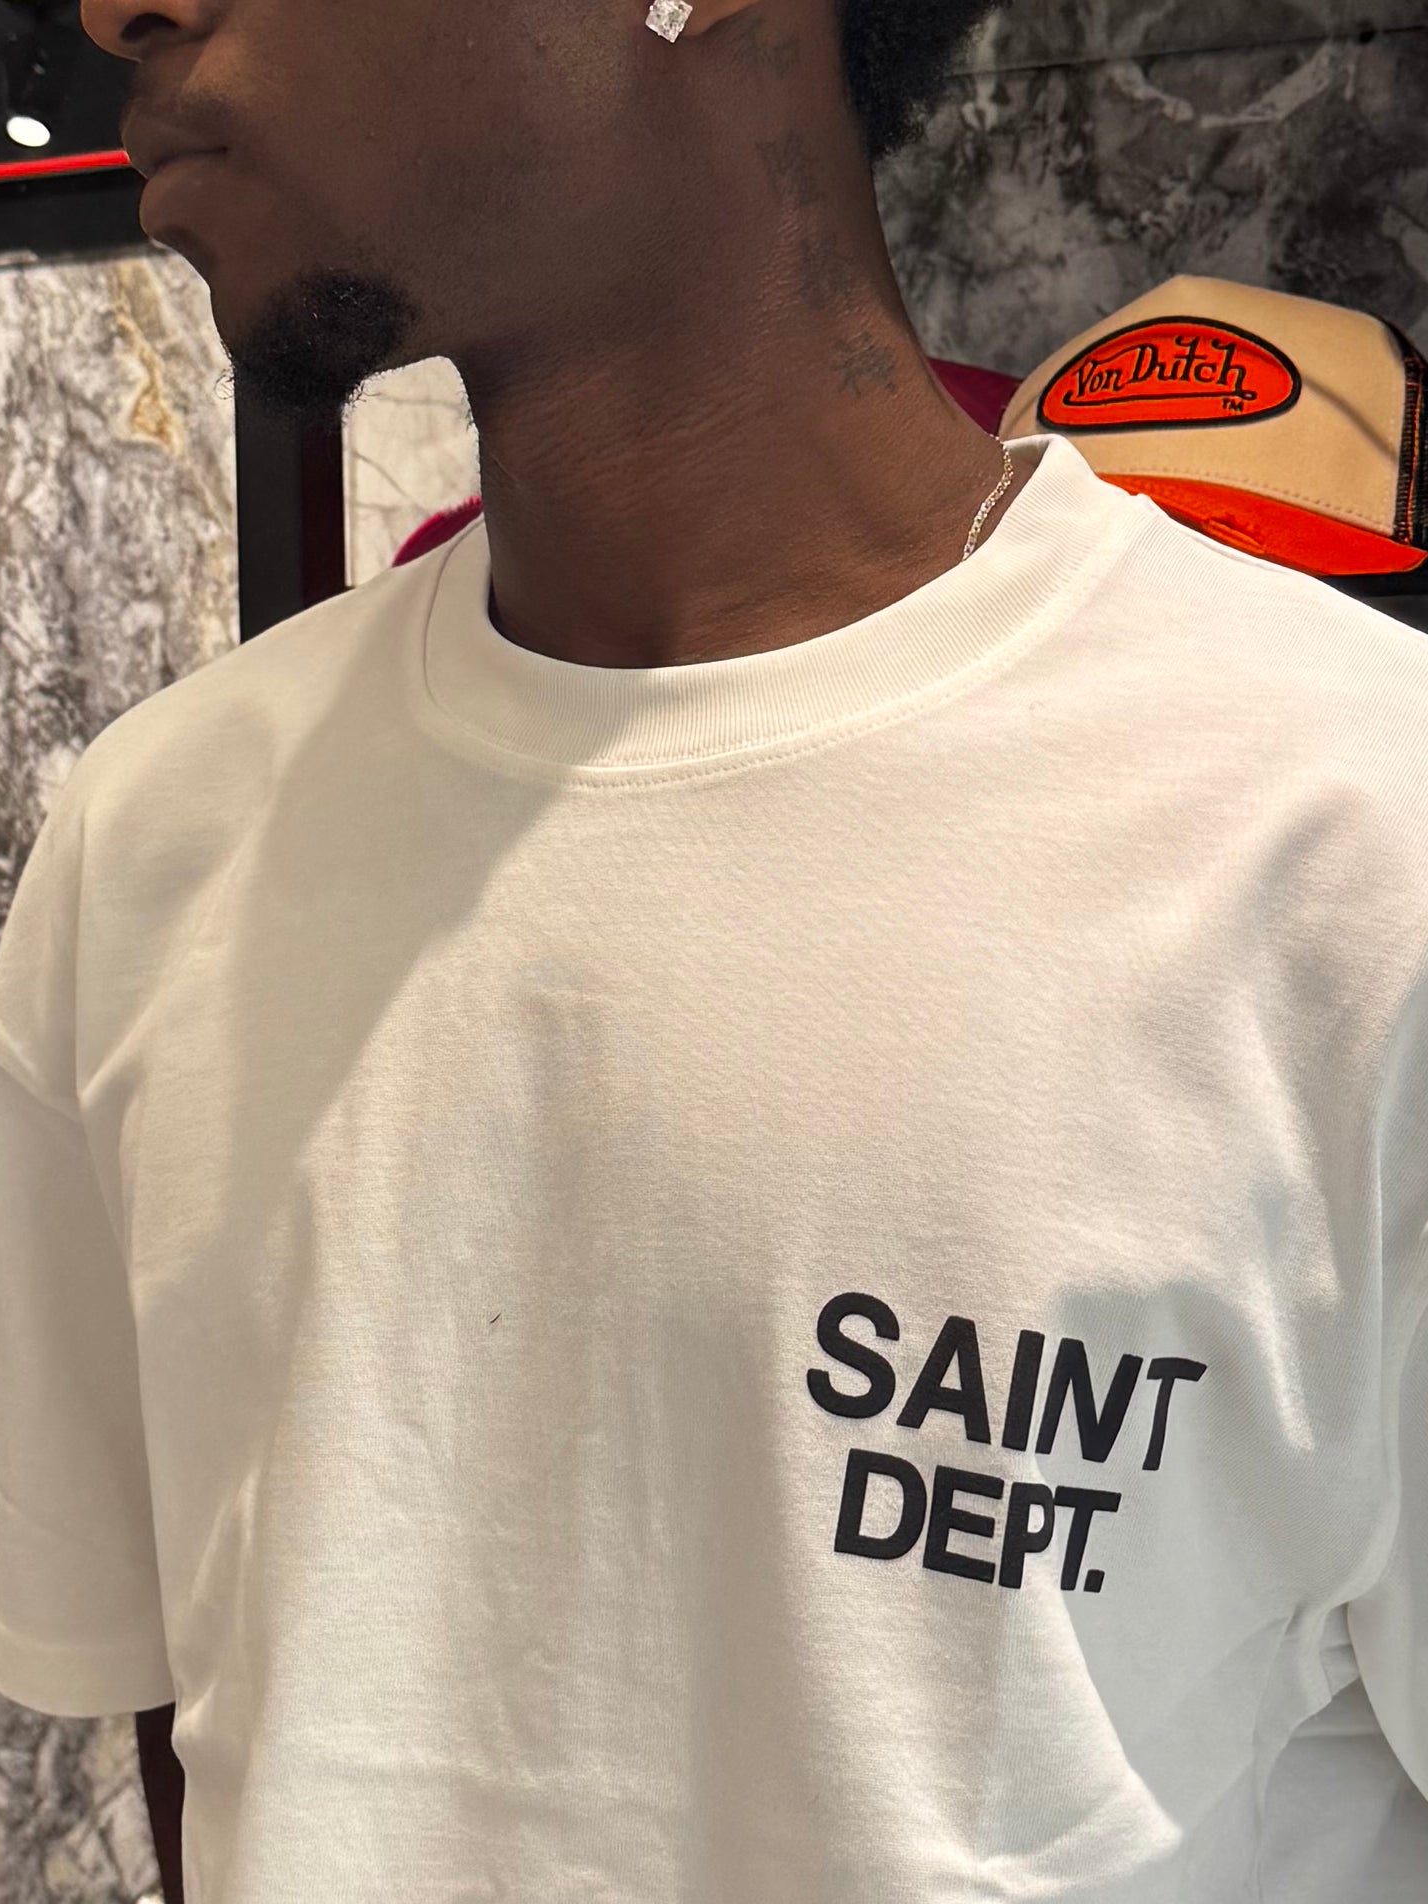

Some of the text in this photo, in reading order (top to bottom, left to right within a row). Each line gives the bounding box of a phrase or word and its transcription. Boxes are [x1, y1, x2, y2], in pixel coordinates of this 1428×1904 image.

[1075, 335, 1248, 397] Von Dutch
[1222, 398, 1245, 412] TM
[806, 1291, 1208, 1472] SAINT
[833, 1447, 1122, 1594] DEPT.
